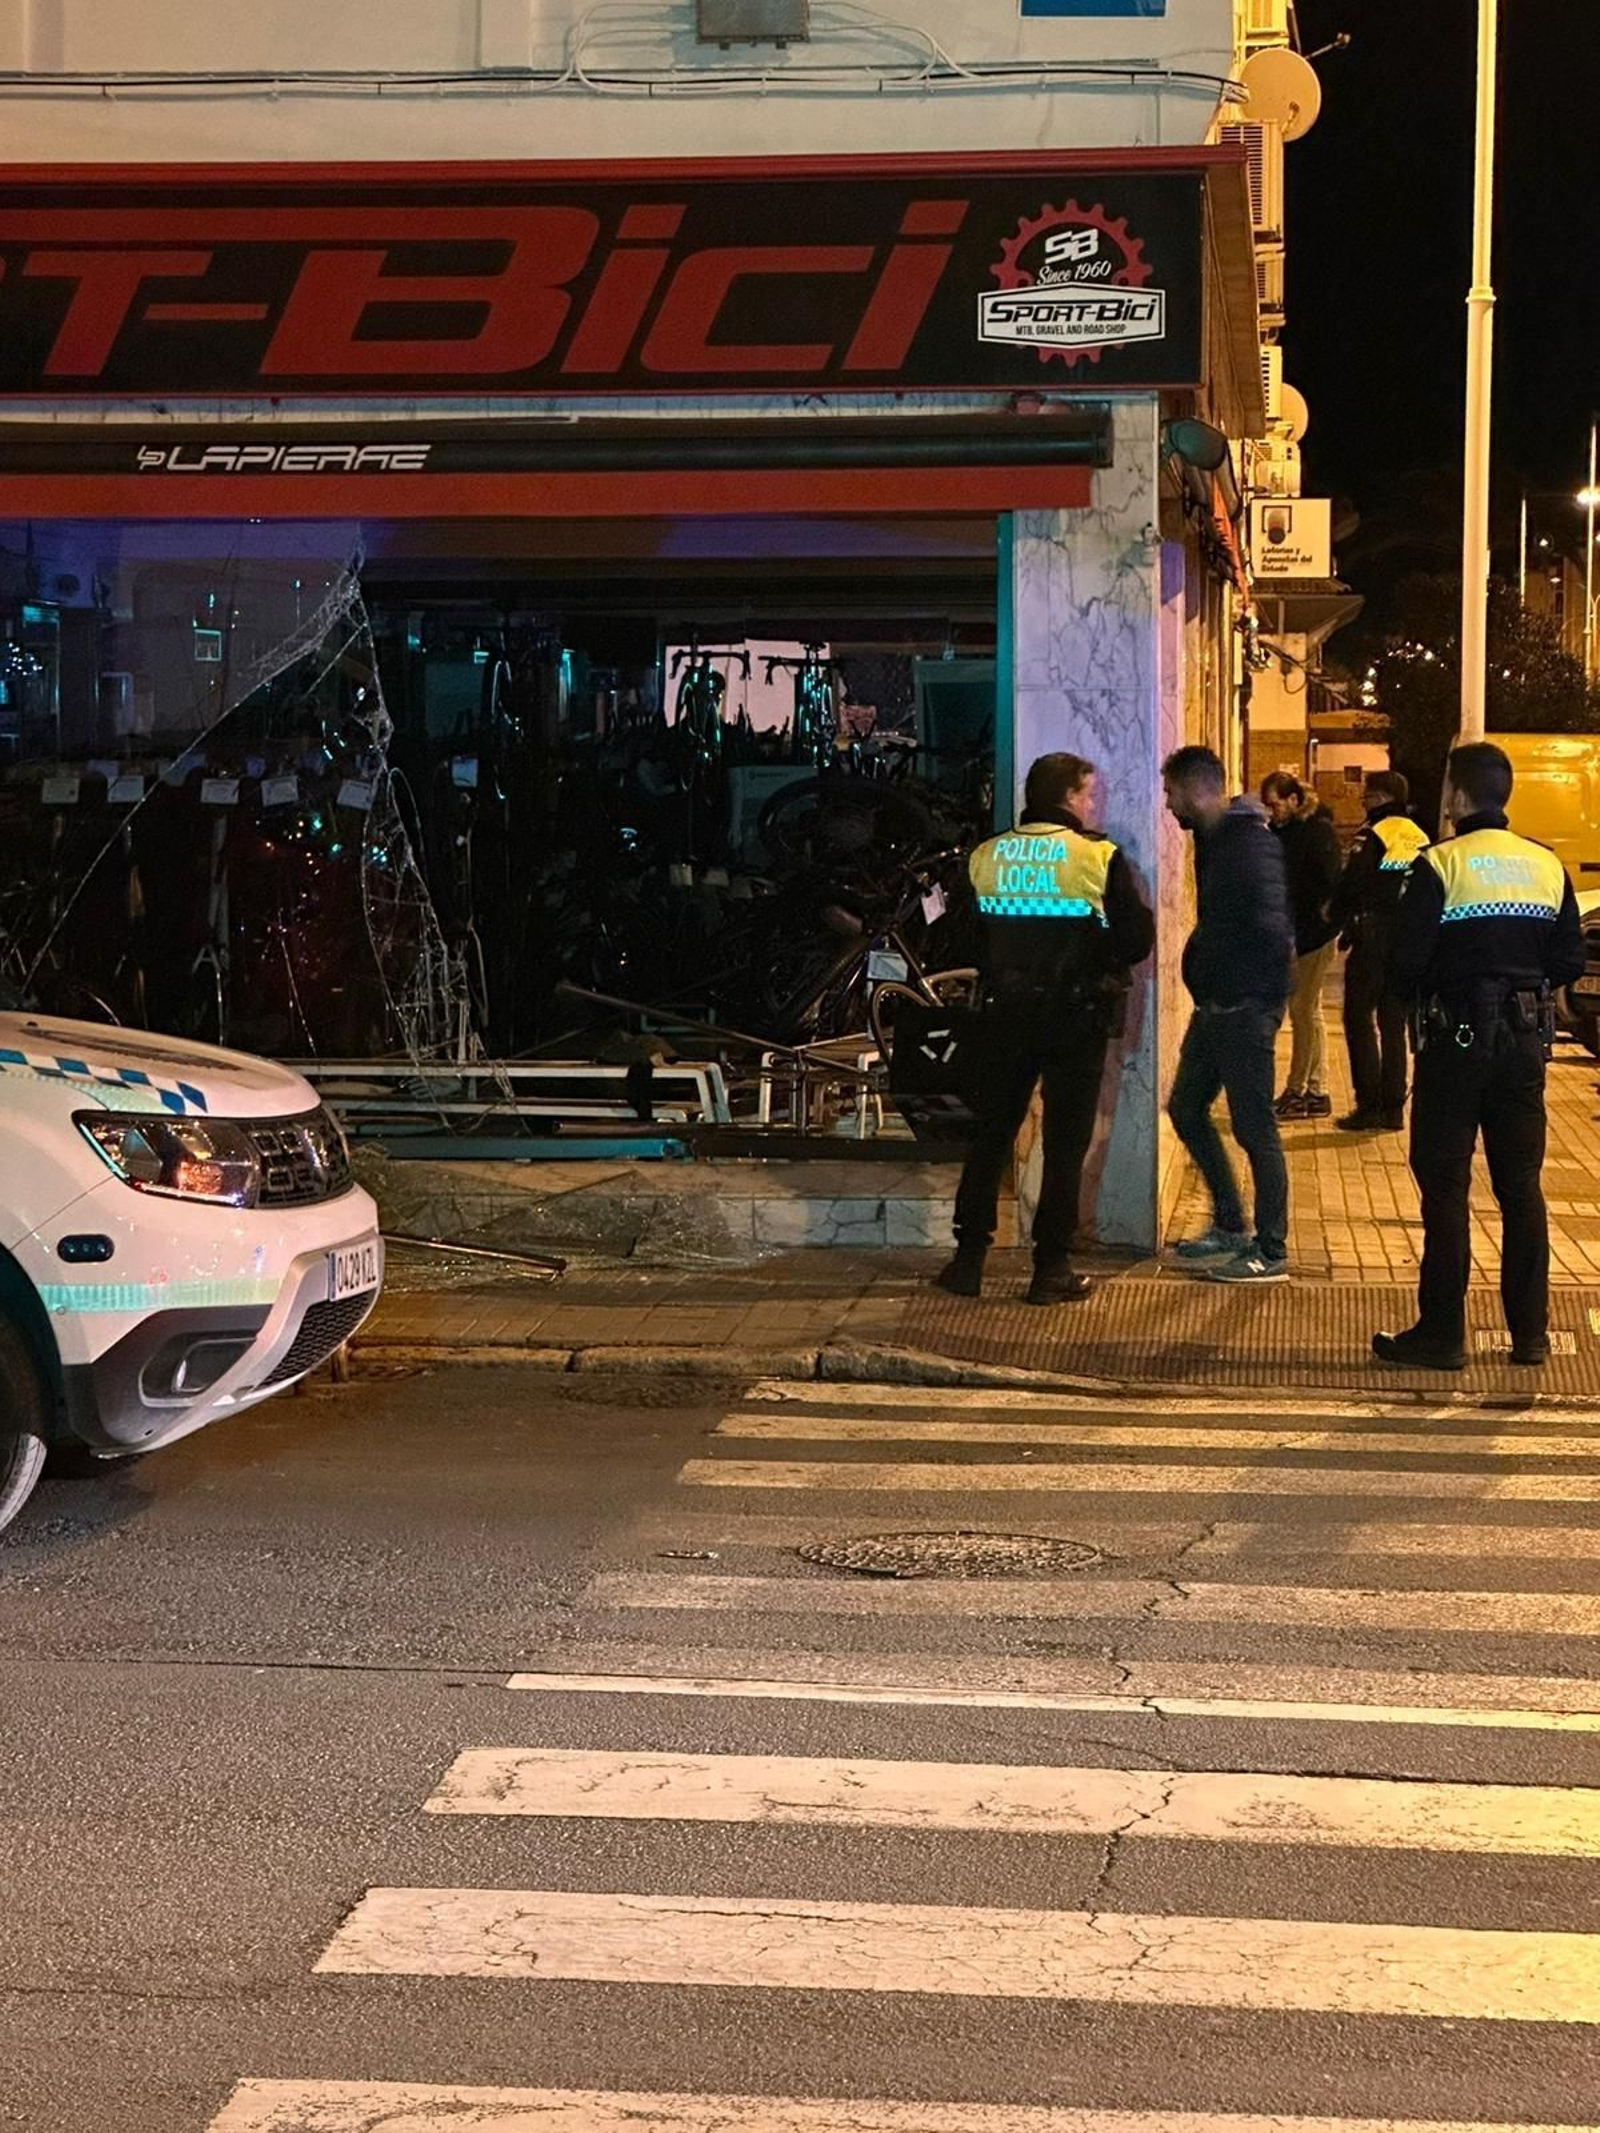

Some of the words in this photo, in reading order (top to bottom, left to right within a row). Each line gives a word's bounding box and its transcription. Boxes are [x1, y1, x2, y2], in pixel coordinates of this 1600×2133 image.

[1044, 228, 1099, 264] SB
[1036, 265, 1071, 286] Since
[1074, 260, 1111, 280] 1960
[1036, 325, 1064, 335] GRAVEL
[1066, 325, 1082, 335] AND
[1084, 324, 1104, 334] ROAD
[1106, 324, 1127, 334] SHOP
[996, 864, 1061, 894] LOCAL
[337, 1252, 360, 1292] 0429
